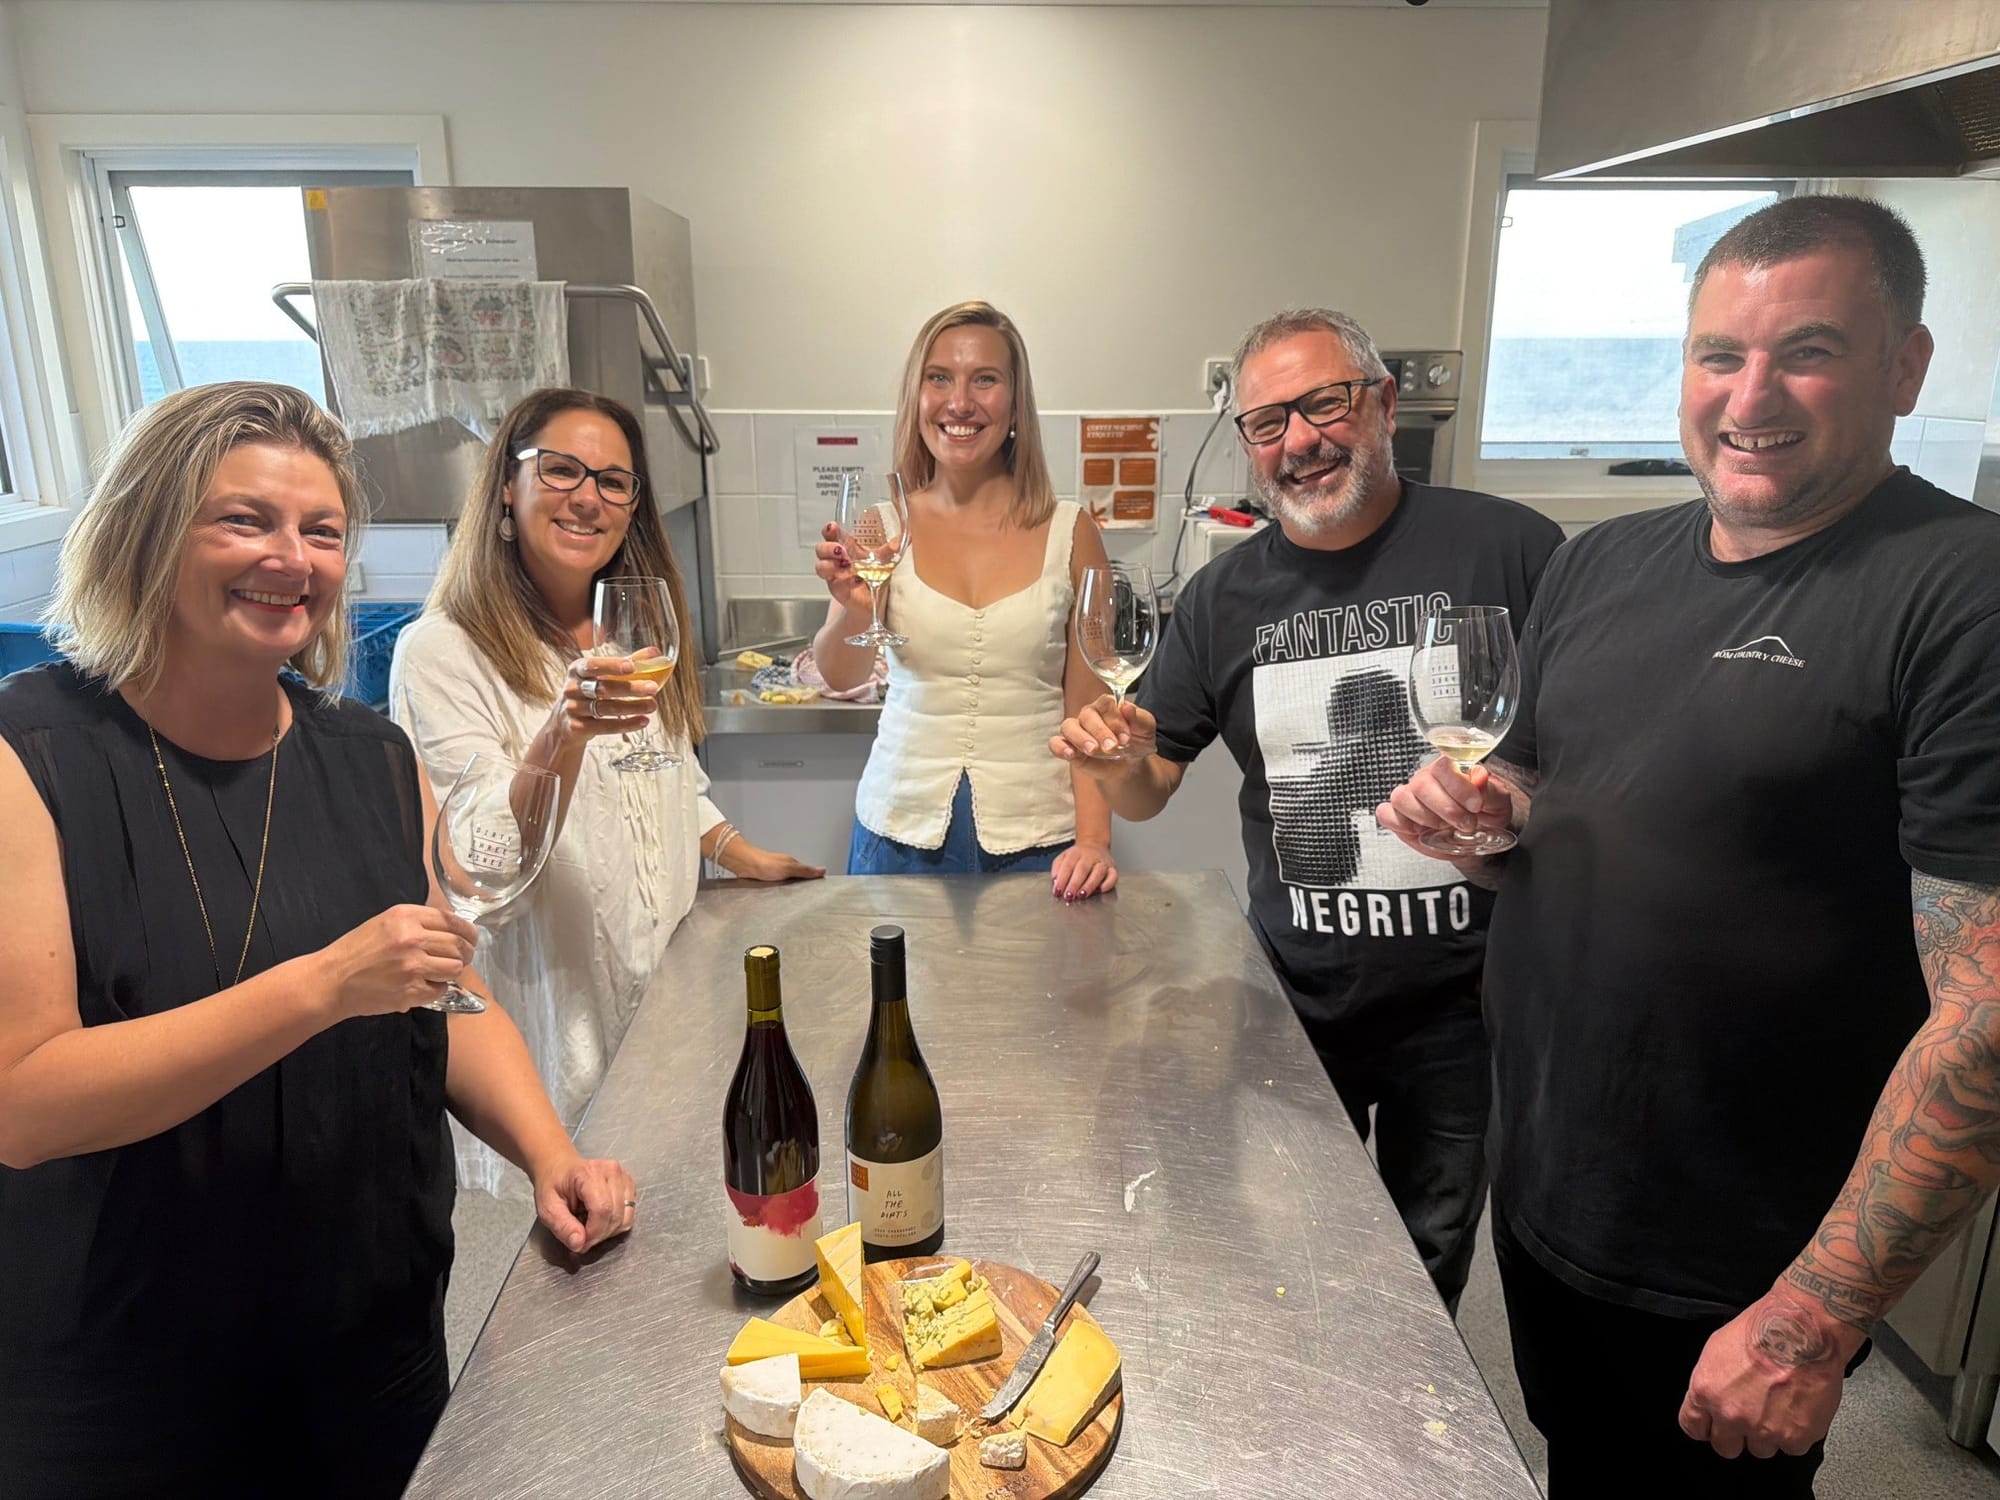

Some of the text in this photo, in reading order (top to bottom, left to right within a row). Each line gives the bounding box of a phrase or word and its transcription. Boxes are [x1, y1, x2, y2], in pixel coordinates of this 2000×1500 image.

[1252, 591, 1453, 664] FANTASTIC
[1770, 654, 1806, 668] CHEESE
[475, 826, 513, 842] DIRTY
[473, 840, 508, 856] THREE
[468, 853, 503, 868] WINES
[1288, 885, 1471, 937] NEGRITO
[886, 1190, 903, 1199] ALL
[884, 1200, 904, 1209] THE
